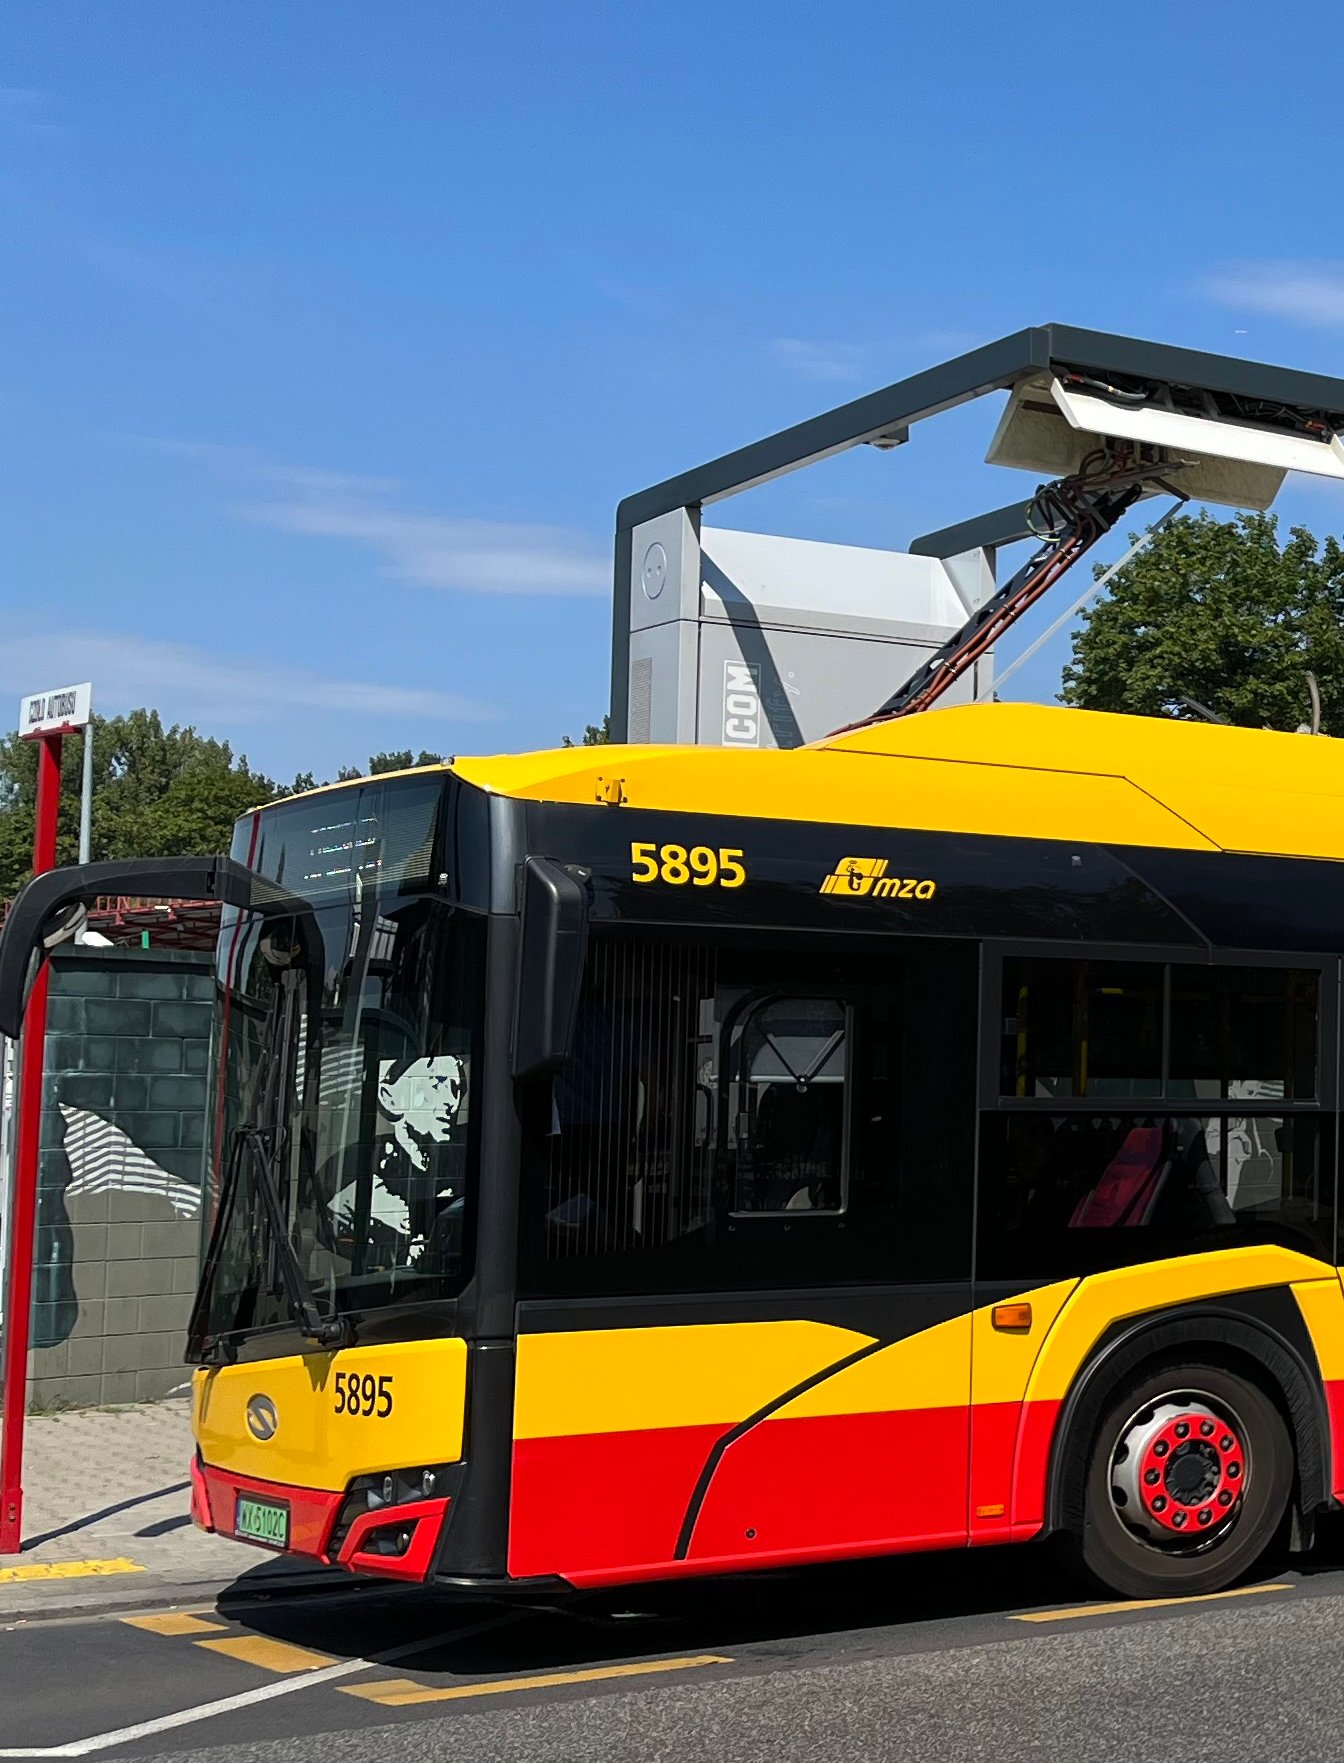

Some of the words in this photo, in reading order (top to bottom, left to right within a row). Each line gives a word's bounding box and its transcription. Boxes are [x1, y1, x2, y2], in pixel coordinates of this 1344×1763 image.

[726, 665, 758, 740] COM
[631, 842, 746, 888] 5895
[872, 877, 936, 899] mza
[334, 1372, 393, 1418] 5895
